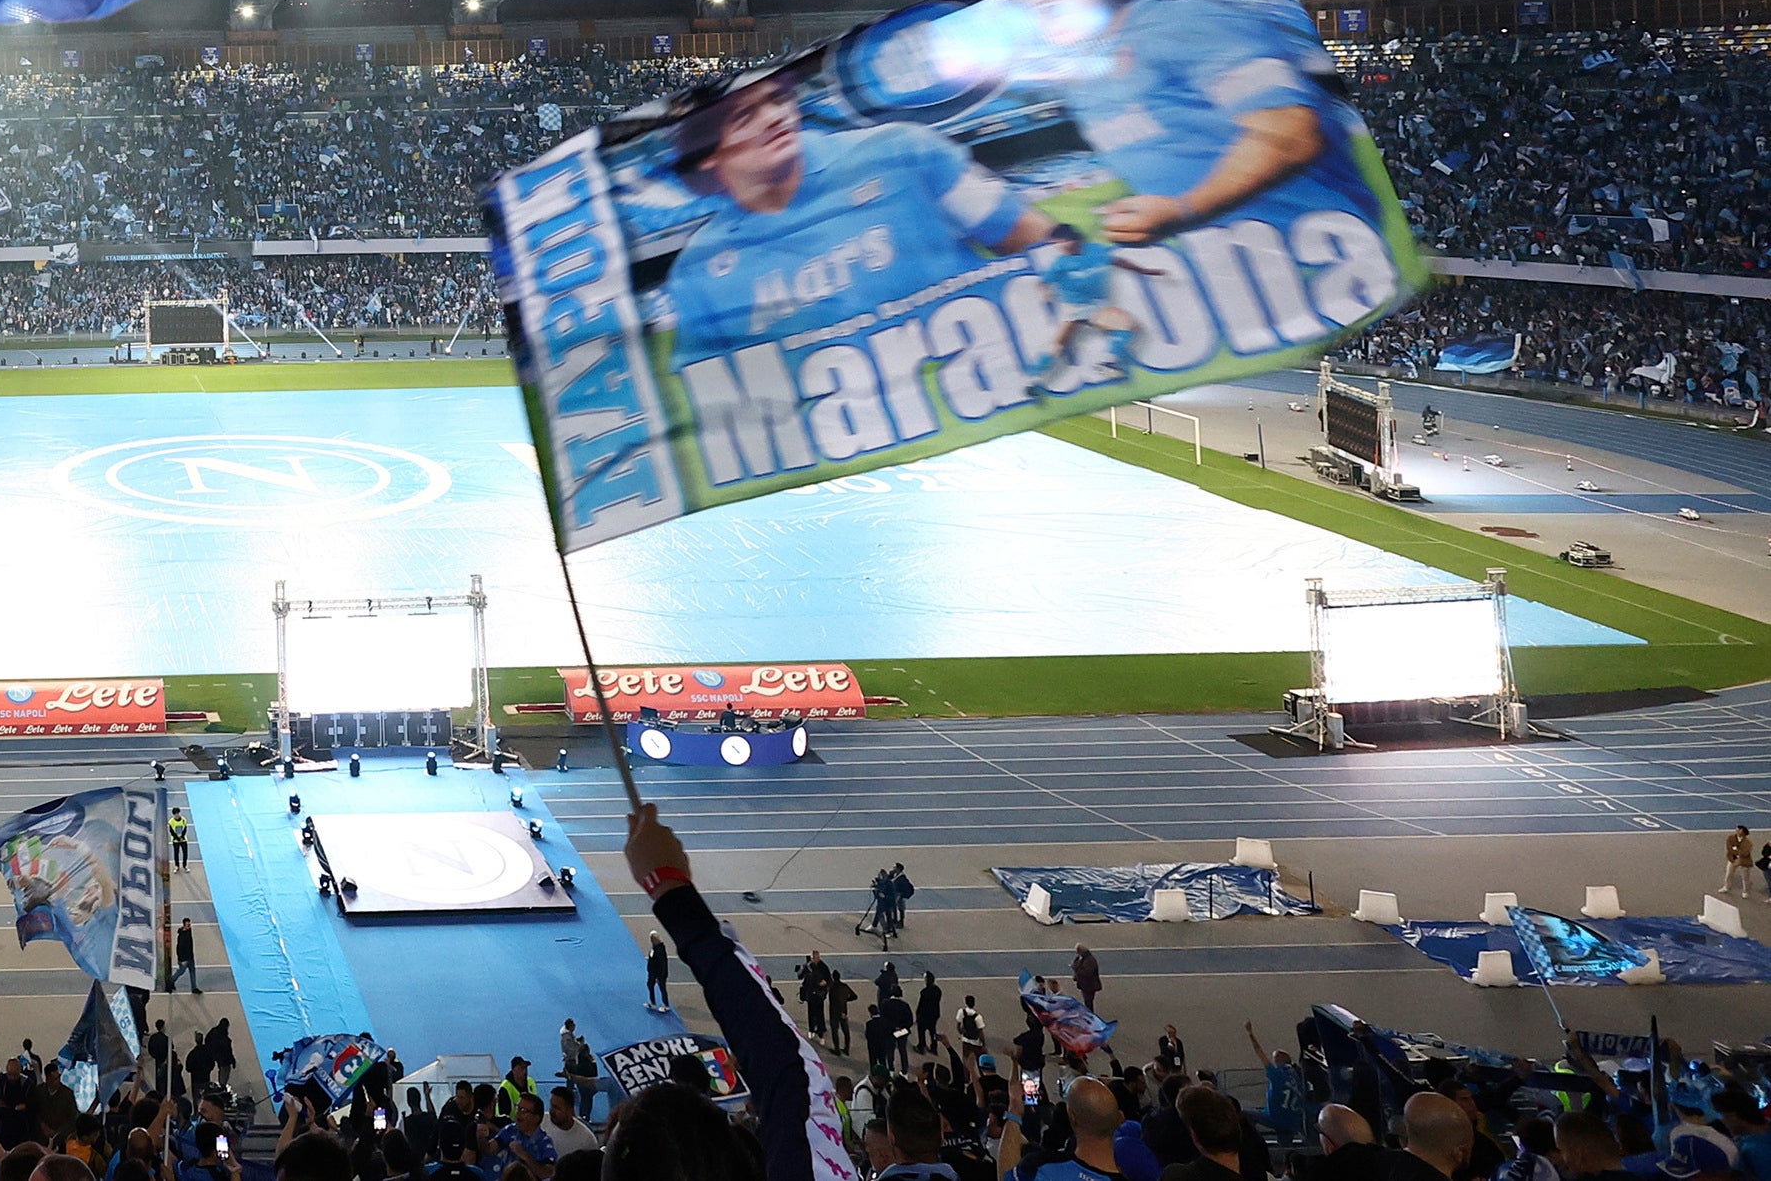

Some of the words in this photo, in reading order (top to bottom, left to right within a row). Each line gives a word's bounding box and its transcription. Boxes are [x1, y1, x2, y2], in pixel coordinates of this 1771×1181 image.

[748, 223, 895, 336] Mars
[516, 151, 662, 530] NAPOLI
[684, 211, 1397, 486] Maradona
[574, 670, 683, 699] Lete
[740, 666, 850, 696] Lete
[46, 681, 158, 713] Lete
[691, 694, 708, 703] SSC
[711, 693, 744, 703] NAPOLI
[14, 708, 47, 719] NAPOLI
[612, 710, 632, 721] Lete
[667, 710, 689, 720] Lete
[694, 709, 717, 719] Lete
[751, 708, 773, 718] Lete
[807, 707, 829, 717] Lete
[835, 706, 857, 717] Lete
[23, 724, 45, 735] Lete
[51, 724, 73, 734] Lete
[79, 723, 101, 733] Lete
[107, 722, 129, 733] Lete
[135, 722, 157, 733] Lete
[1521, 767, 1547, 779] 5
[1592, 799, 1617, 811] 7
[1632, 816, 1661, 829] 8
[613, 1037, 699, 1072] AMORE
